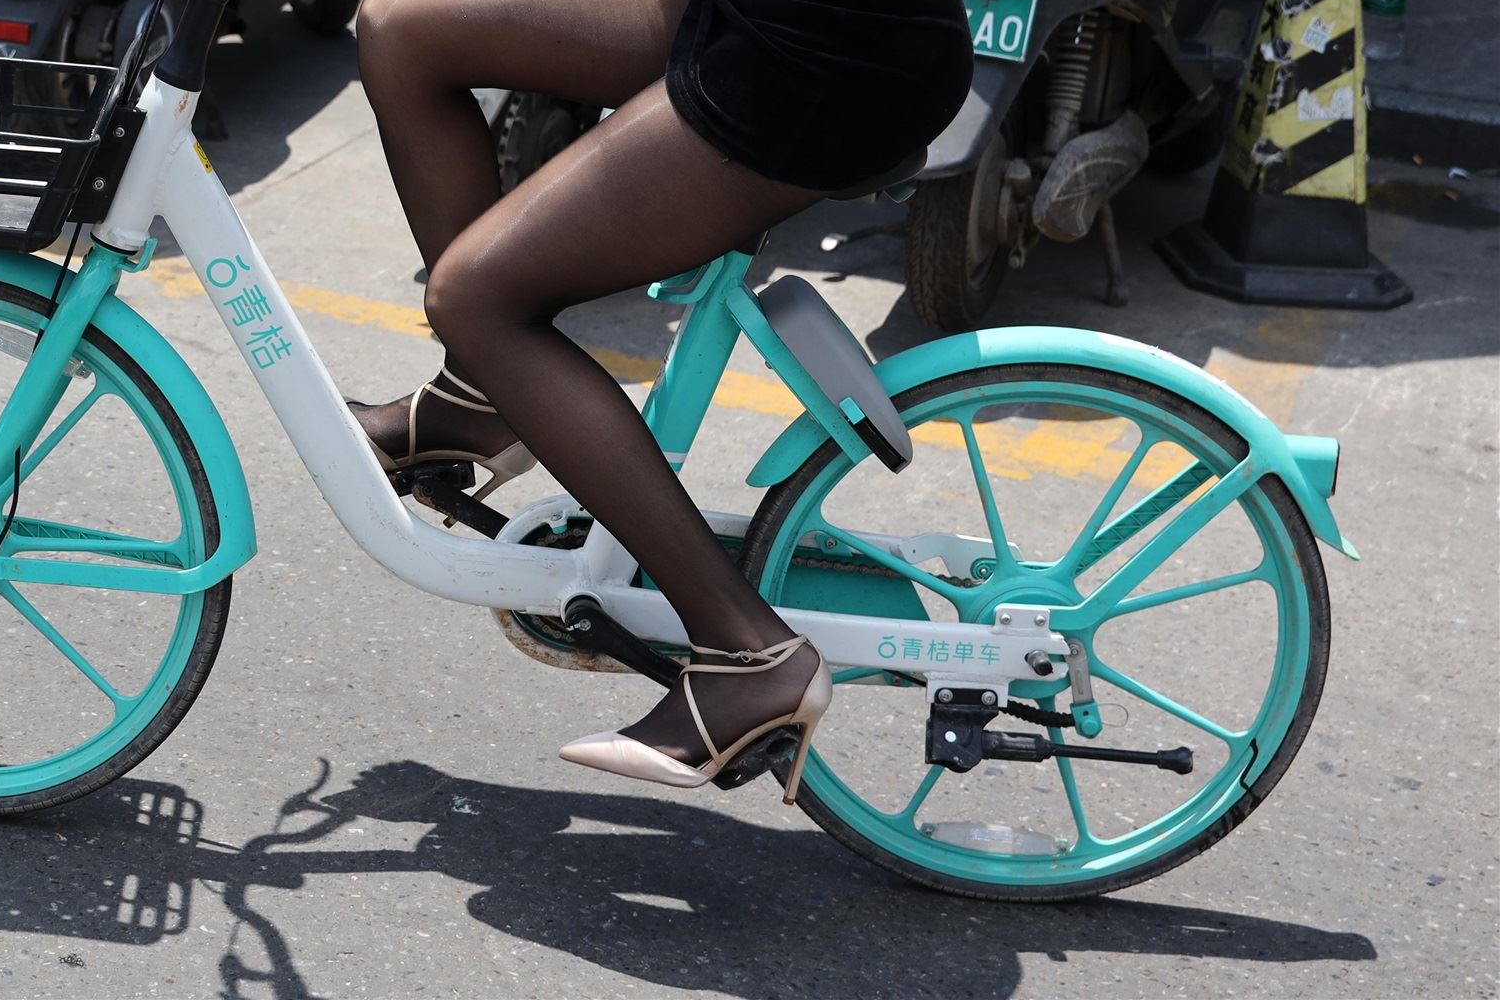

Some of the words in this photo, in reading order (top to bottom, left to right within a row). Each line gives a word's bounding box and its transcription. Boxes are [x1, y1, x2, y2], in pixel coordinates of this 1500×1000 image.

[965, 8, 1024, 53] A0
[222, 283, 293, 370] 青桔
[901, 637, 1001, 665] 青桔单车
